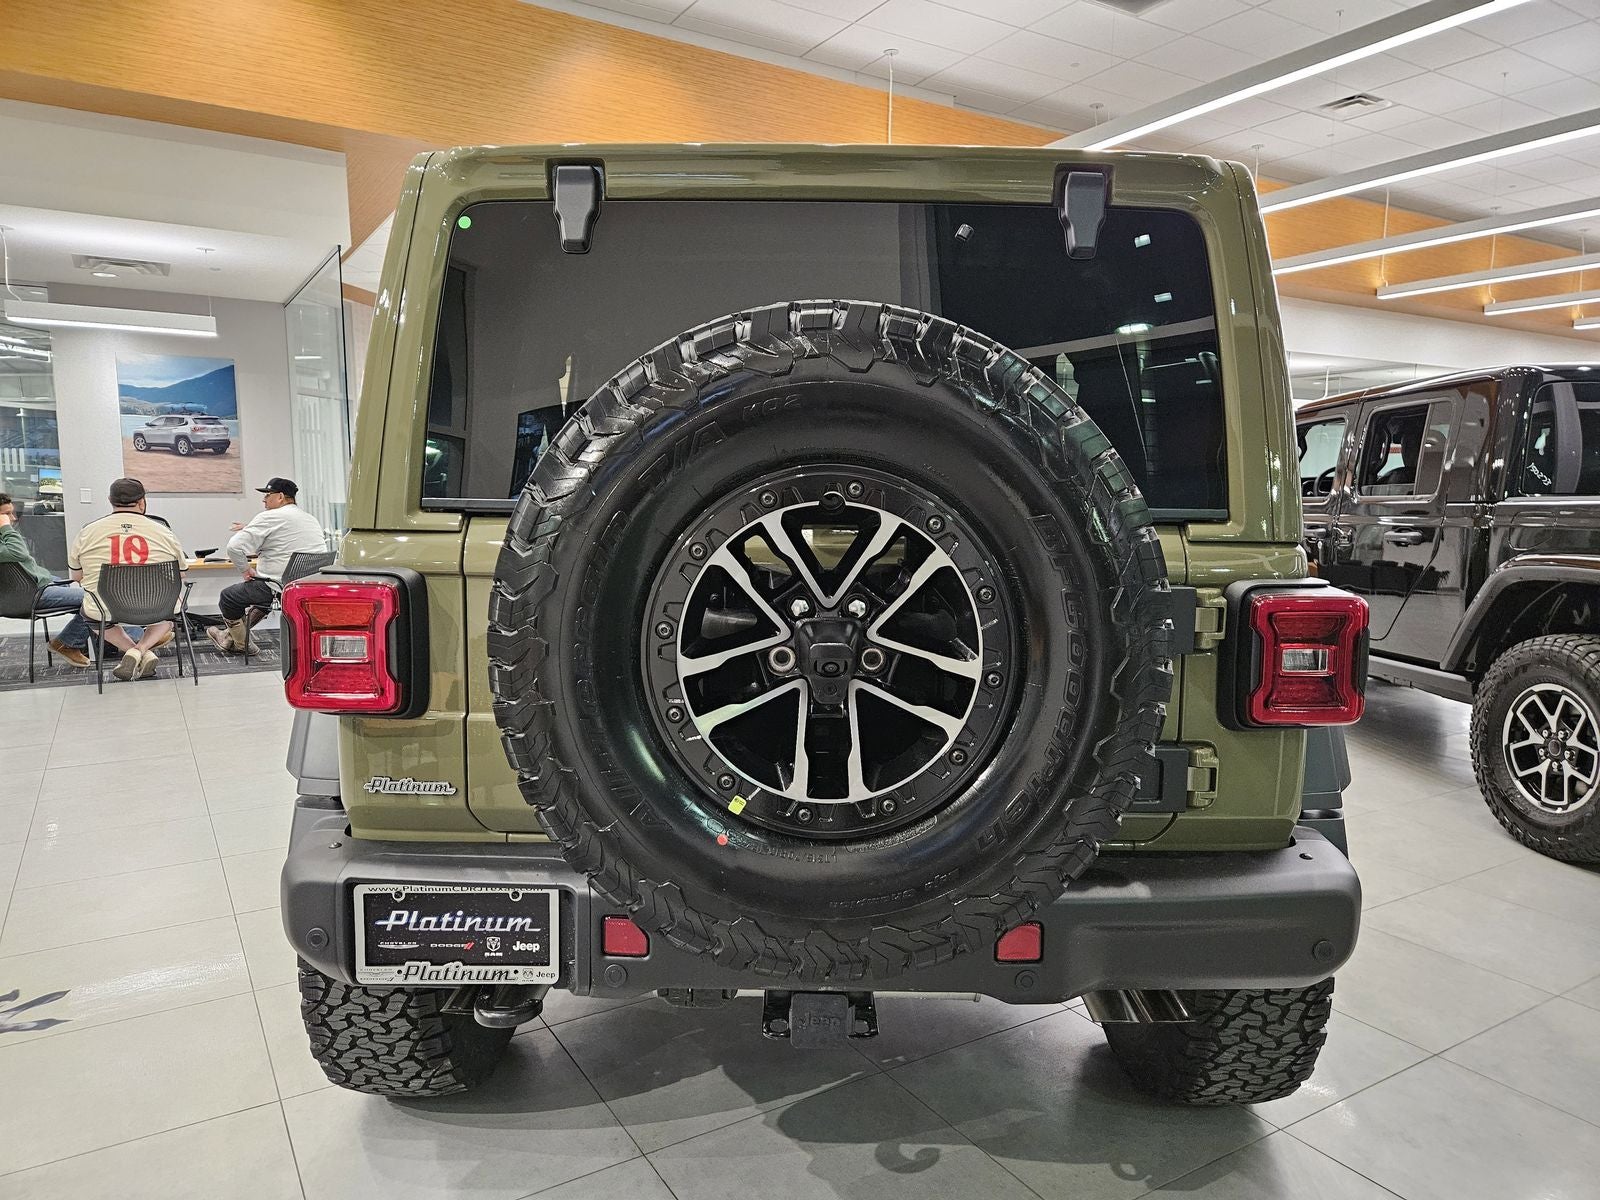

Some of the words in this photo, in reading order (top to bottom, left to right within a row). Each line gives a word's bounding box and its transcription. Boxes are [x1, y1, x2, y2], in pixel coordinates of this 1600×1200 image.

[107, 534, 149, 565] 10
[363, 776, 457, 796] Platinum
[375, 910, 541, 932] Platinum
[512, 941, 541, 953] Jeep
[403, 965, 517, 982] Platinum
[536, 971, 556, 979] Jeep
